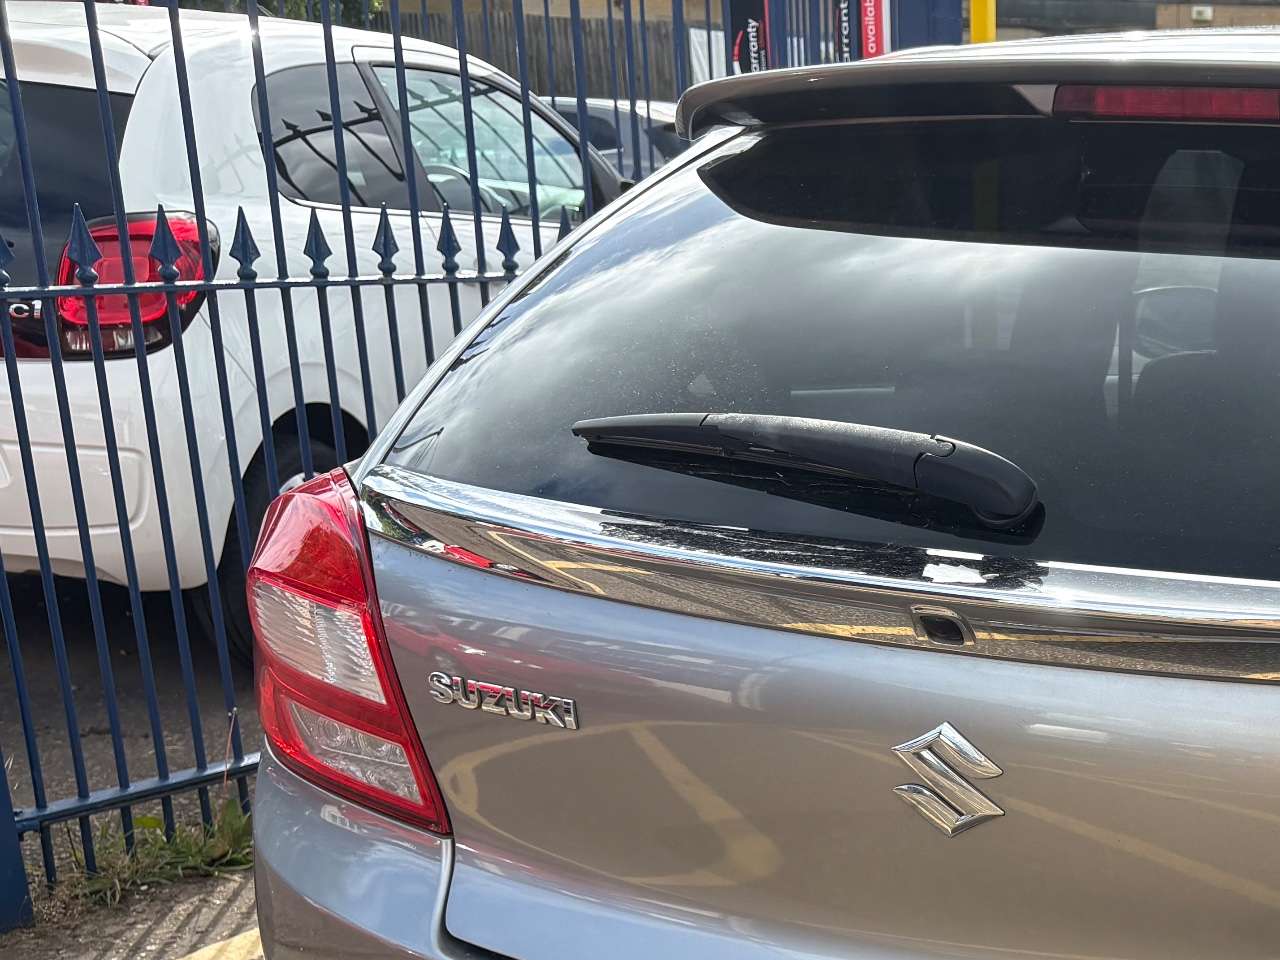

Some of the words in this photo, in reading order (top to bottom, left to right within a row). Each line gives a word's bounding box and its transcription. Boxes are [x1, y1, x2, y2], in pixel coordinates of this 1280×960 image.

[747, 18, 760, 72] arranty
[840, 0, 850, 62] arrant
[864, 0, 876, 53] availab
[427, 671, 580, 731] SUZUKI
